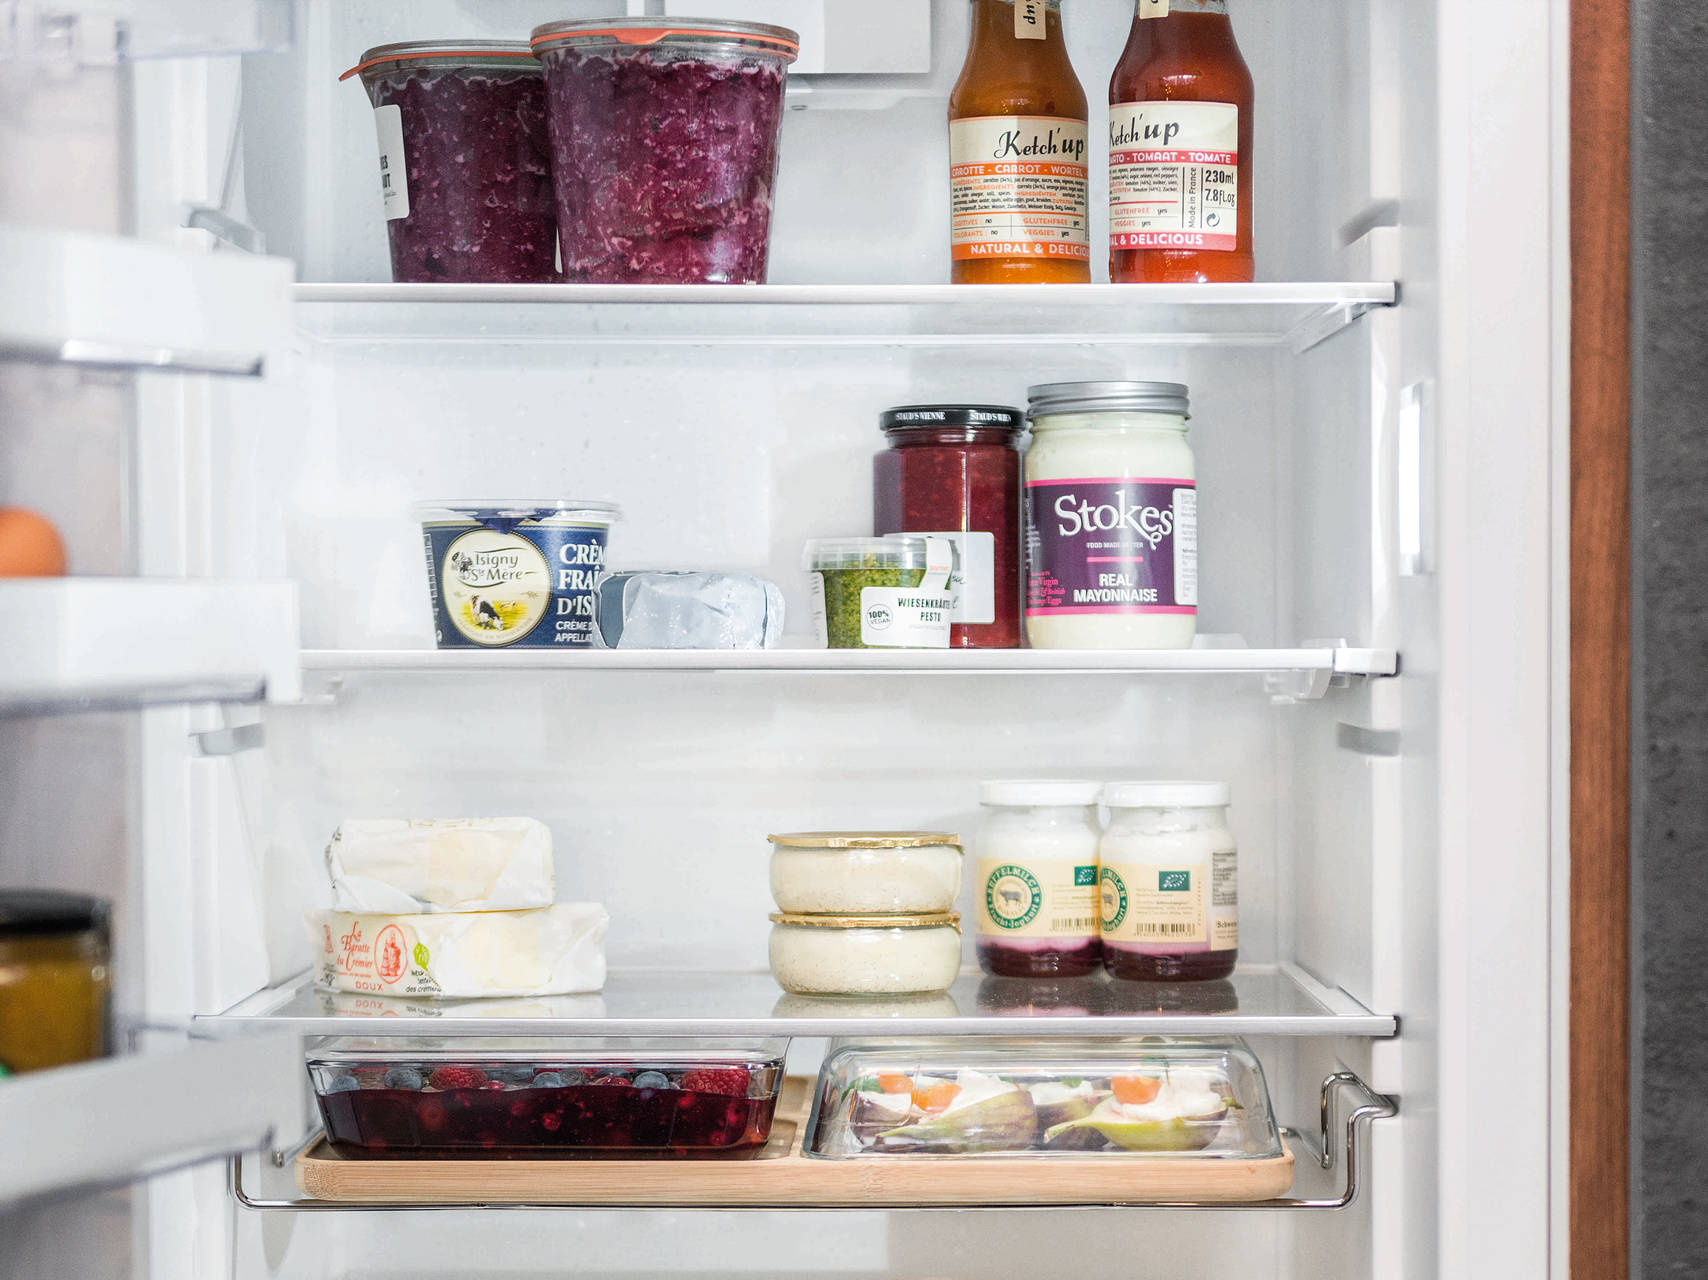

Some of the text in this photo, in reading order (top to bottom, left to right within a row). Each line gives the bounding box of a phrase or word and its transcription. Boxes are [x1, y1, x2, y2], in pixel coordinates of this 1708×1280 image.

[994, 127, 1084, 161] Ketch'up
[1132, 152, 1178, 162] TOMAAT
[1188, 152, 1232, 163] TOMATE
[995, 164, 1041, 174] CARROT
[1051, 165, 1083, 177] WORTEL
[1205, 169, 1235, 184] 230ml
[1188, 167, 1197, 195] France
[1188, 207, 1197, 228] Made
[1120, 235, 1127, 246] &
[1130, 233, 1204, 246] DELICIOUS
[970, 242, 1030, 255] NATURAL
[1034, 243, 1044, 254] &
[1054, 489, 1174, 551] Stokes
[476, 552, 519, 569] Isigny
[557, 564, 601, 590] FRAÎ
[1099, 573, 1134, 587] REAL
[1073, 589, 1158, 603] MAYONNAISE
[868, 610, 889, 619] 100%
[920, 611, 942, 622] PESTO
[355, 980, 383, 991] DOUX
